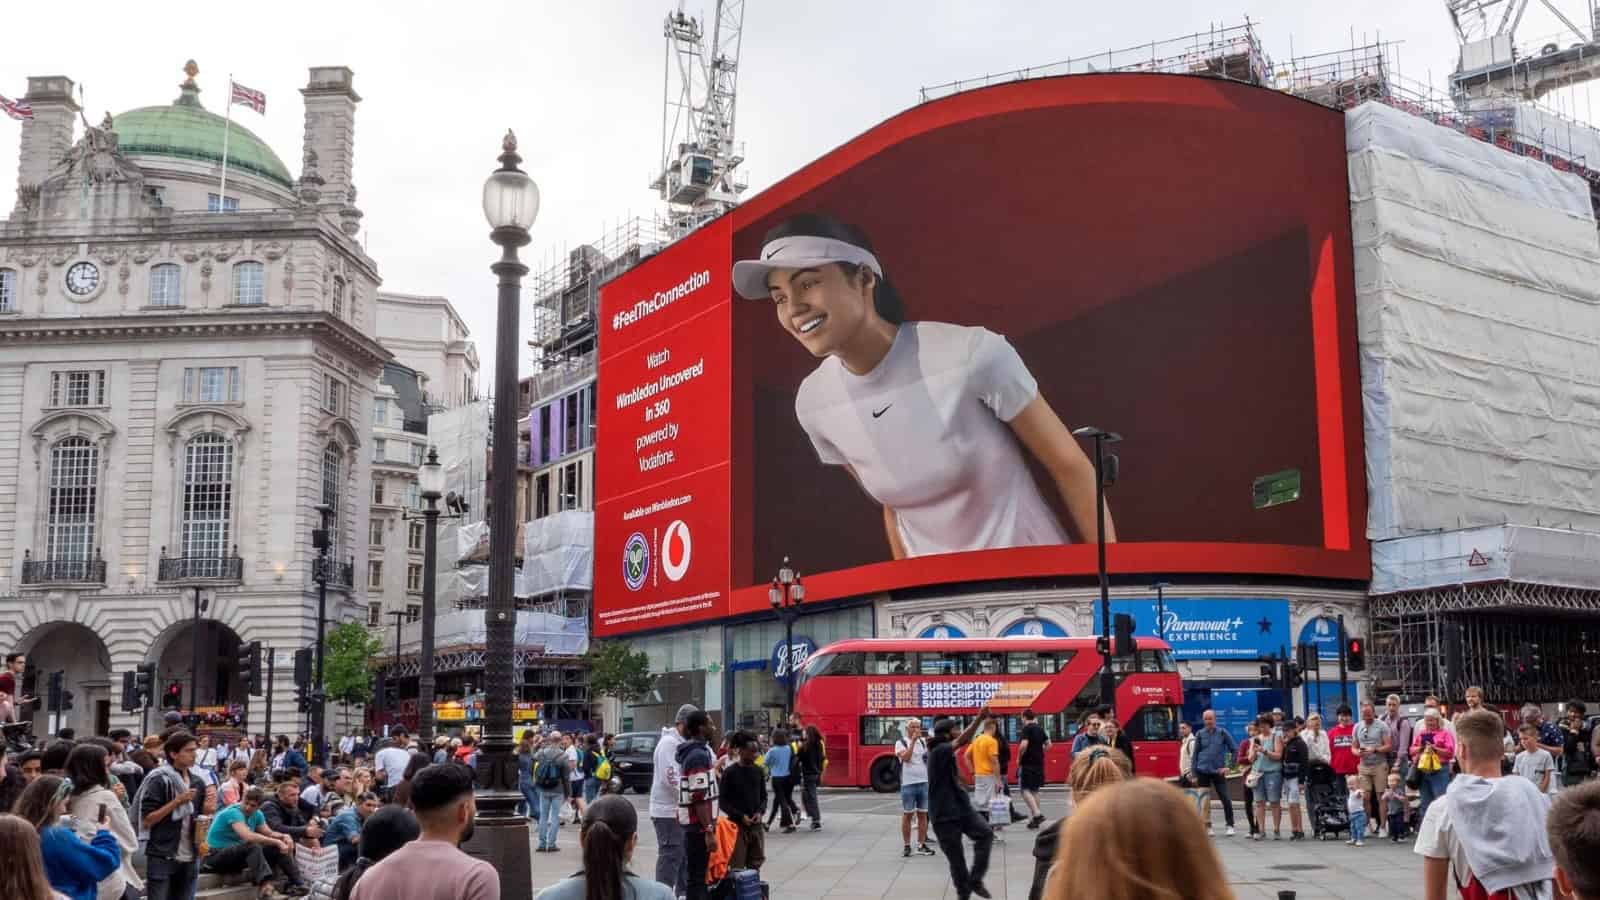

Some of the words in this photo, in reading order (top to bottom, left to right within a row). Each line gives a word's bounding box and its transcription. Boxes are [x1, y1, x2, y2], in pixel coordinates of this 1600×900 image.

[612, 270, 710, 330] #FeelTheConnection
[646, 348, 670, 369] Watch
[616, 381, 658, 409] Wimbledon
[659, 358, 704, 389] Uncovered
[654, 399, 670, 418] 360
[636, 423, 668, 454] powered
[669, 422, 679, 440] by
[1153, 611, 1244, 636] Paramount+
[1168, 632, 1238, 641] EXPERIENCE
[774, 643, 809, 677] Bots
[867, 682, 891, 691] KIDS
[895, 682, 919, 691] BIKE
[867, 692, 891, 700] KIDS
[895, 692, 919, 700] BIKE
[921, 691, 994, 701] SUBSCRIPTIO
[867, 701, 891, 709] KIDS
[895, 701, 919, 709] BIKE
